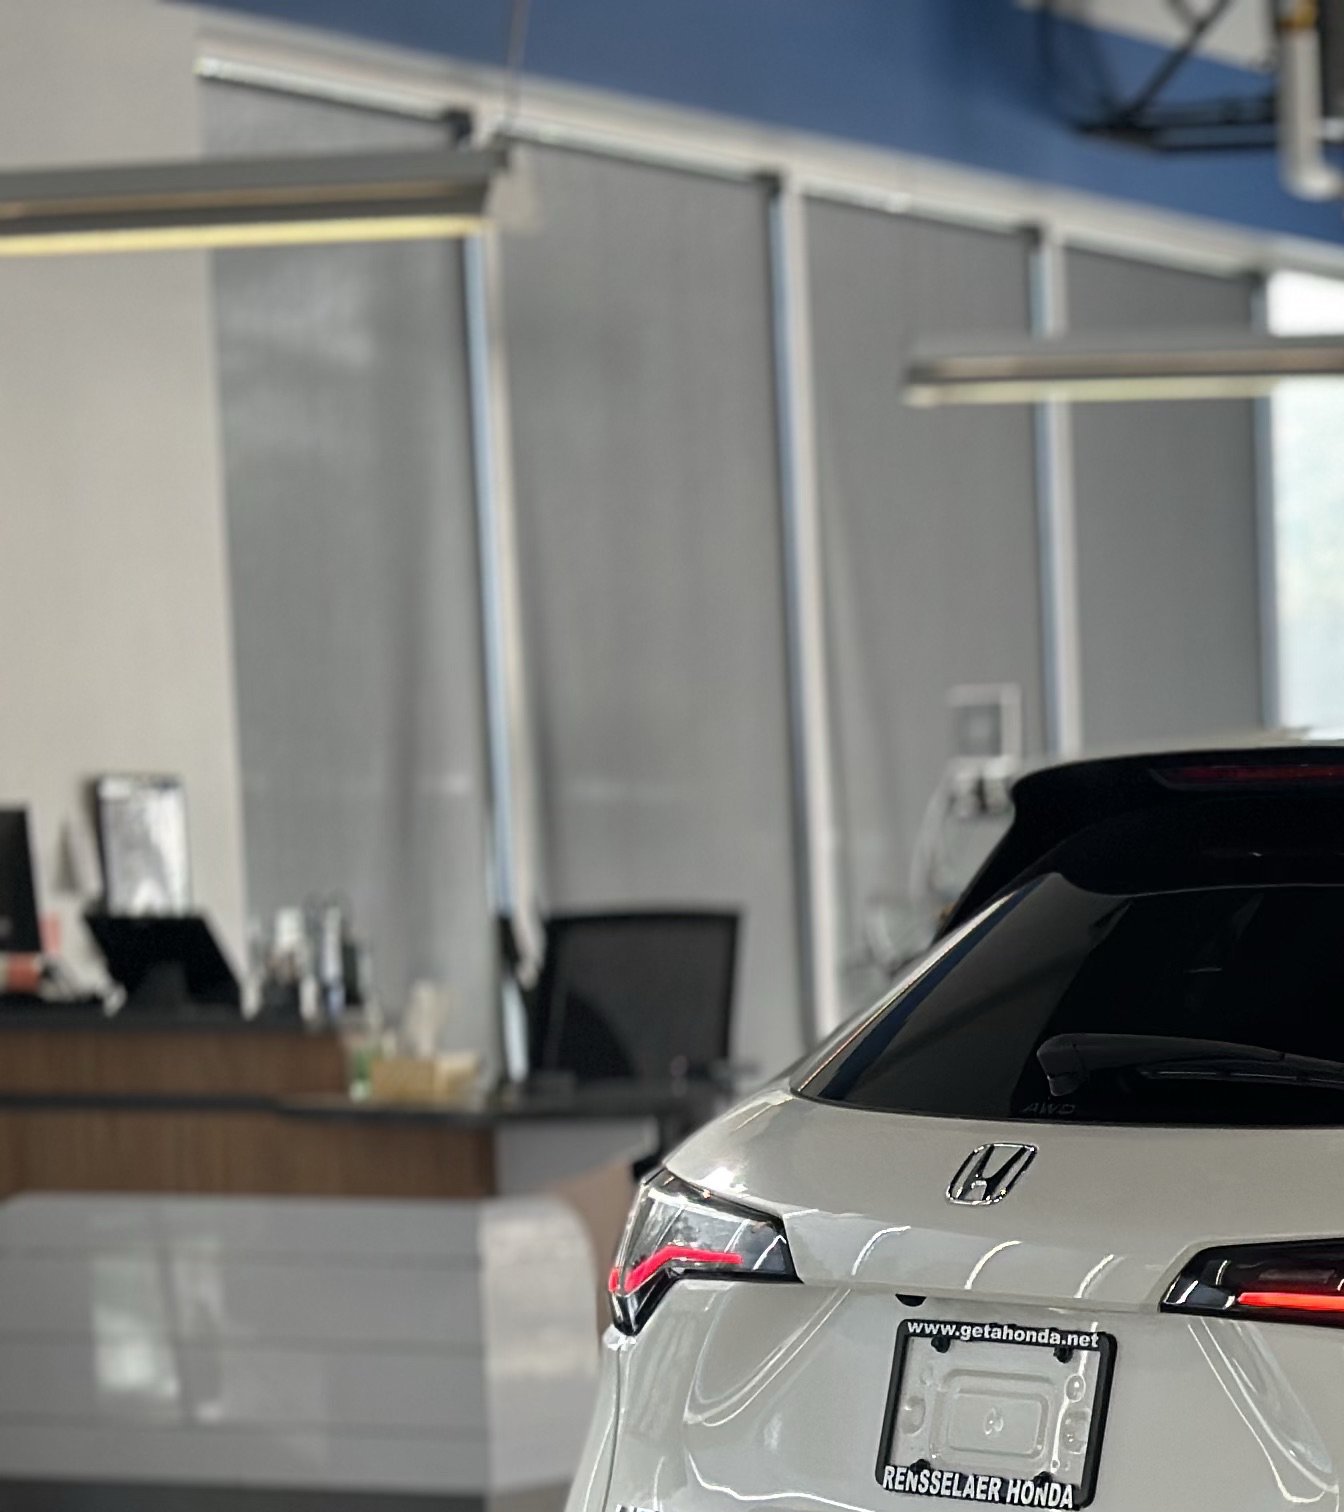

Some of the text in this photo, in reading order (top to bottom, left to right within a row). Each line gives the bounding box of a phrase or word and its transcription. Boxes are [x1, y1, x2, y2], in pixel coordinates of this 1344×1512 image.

[907, 1320, 1099, 1348] www.getahonda.net
[882, 1465, 1073, 1509] RENSSELAER HONDA
